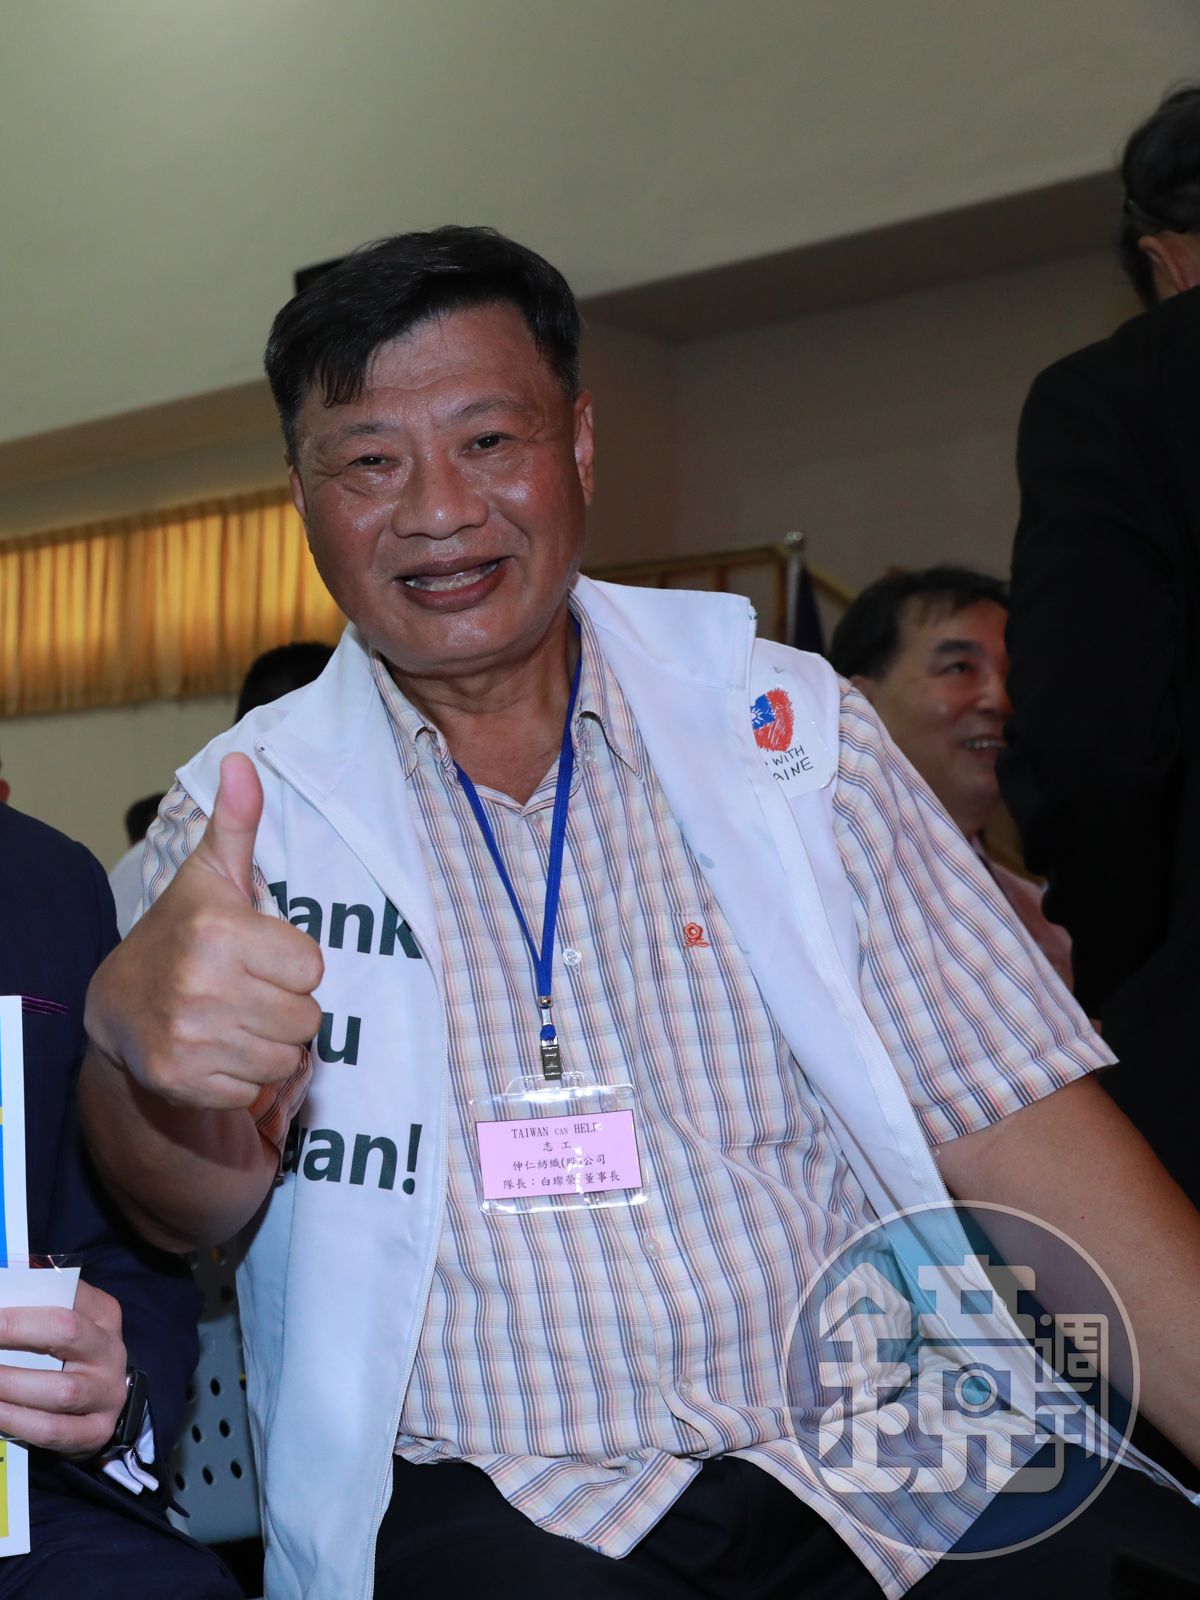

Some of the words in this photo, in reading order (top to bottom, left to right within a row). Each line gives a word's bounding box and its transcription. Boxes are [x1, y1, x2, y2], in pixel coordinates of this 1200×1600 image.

[772, 745, 805, 766] WITH
[511, 1126, 549, 1139] TAIWAN
[554, 1127, 569, 1136] CAN
